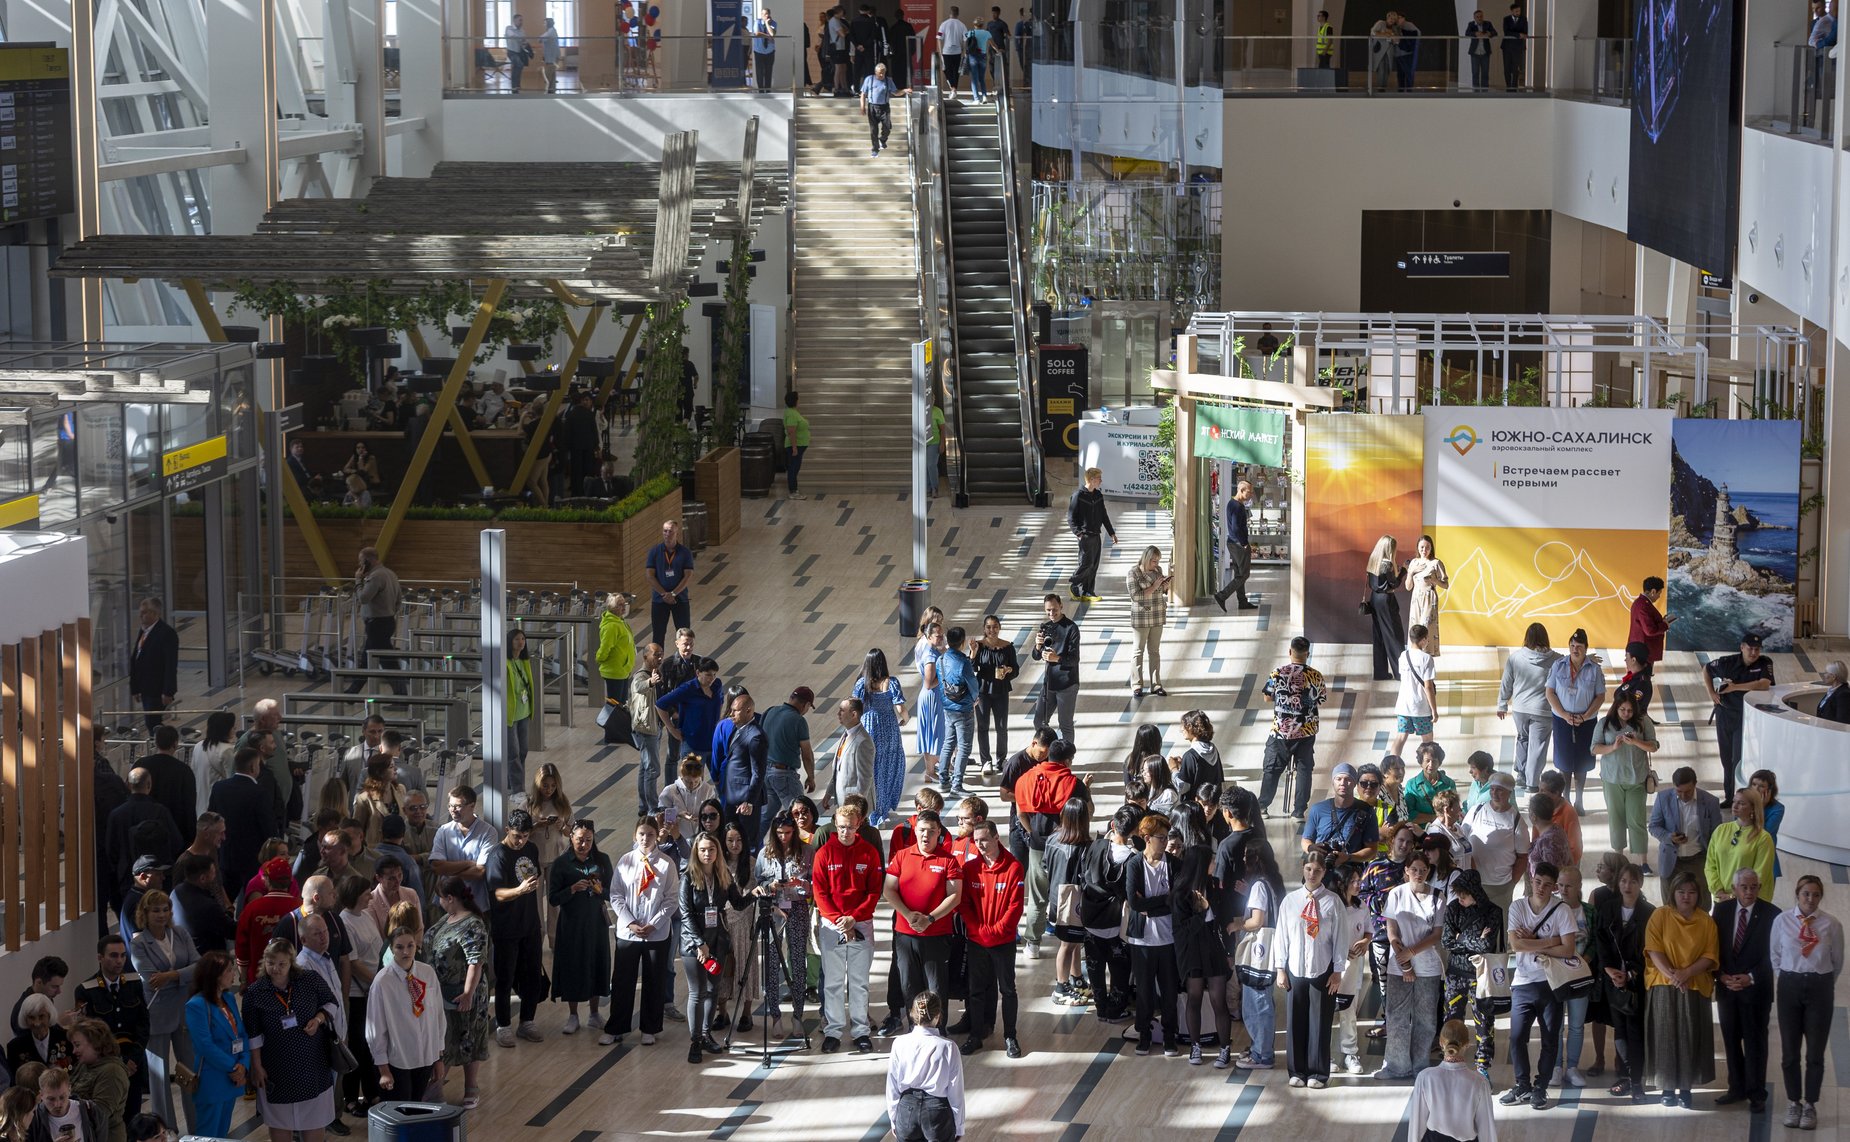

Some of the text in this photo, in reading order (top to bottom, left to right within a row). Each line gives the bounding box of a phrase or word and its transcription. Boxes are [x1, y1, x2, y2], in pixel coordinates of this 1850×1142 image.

[1047, 360, 1075, 368] SOLO
[1107, 432, 1142, 440] ЭКСКУРСИИ
[1491, 430, 1653, 445] ЮЖНО-САХАЛИНСК
[1502, 465, 1621, 478] Встречаем рассвет
[1502, 479, 1558, 489] первыми
